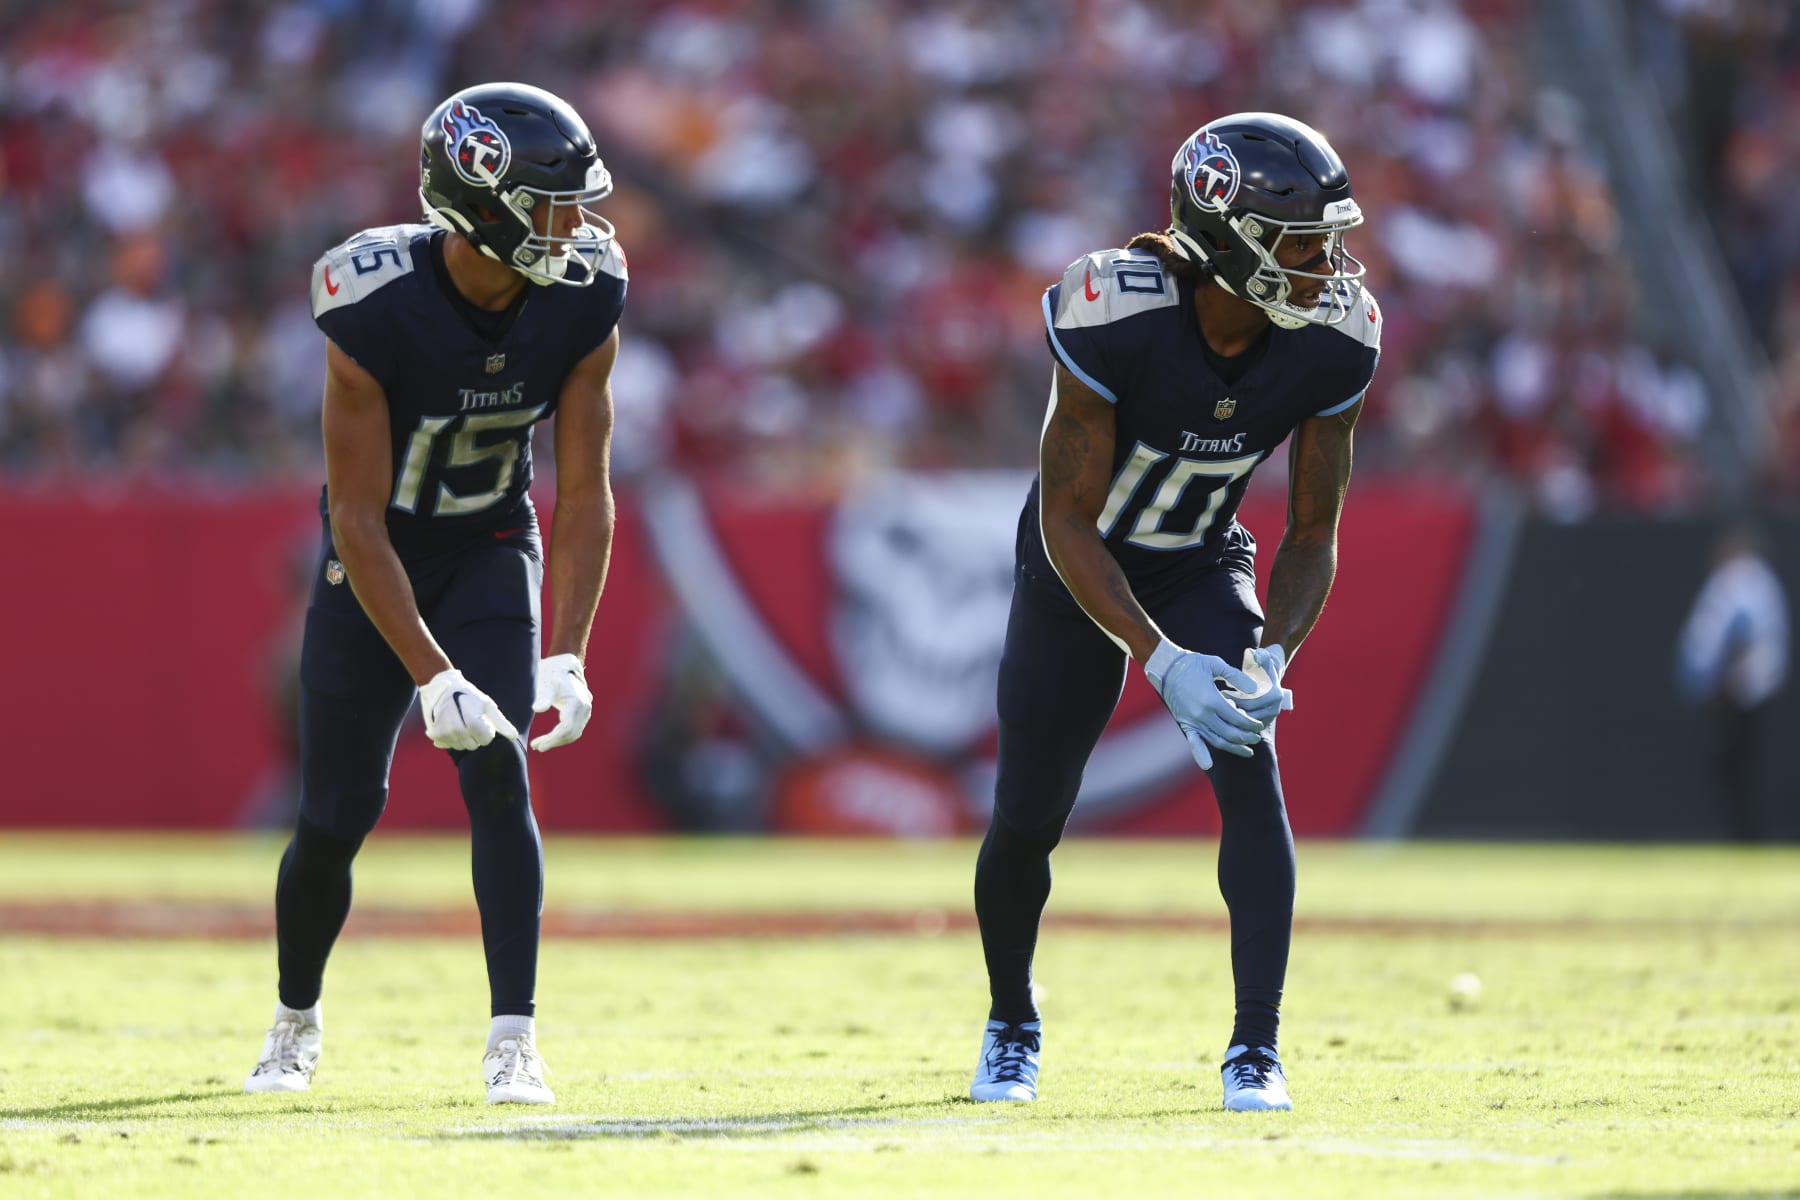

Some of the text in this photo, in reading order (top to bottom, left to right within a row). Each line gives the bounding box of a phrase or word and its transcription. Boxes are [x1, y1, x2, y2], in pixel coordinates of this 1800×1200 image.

[1111, 257, 1166, 296] 10
[390, 401, 548, 517] 15
[1096, 440, 1265, 552] 10
